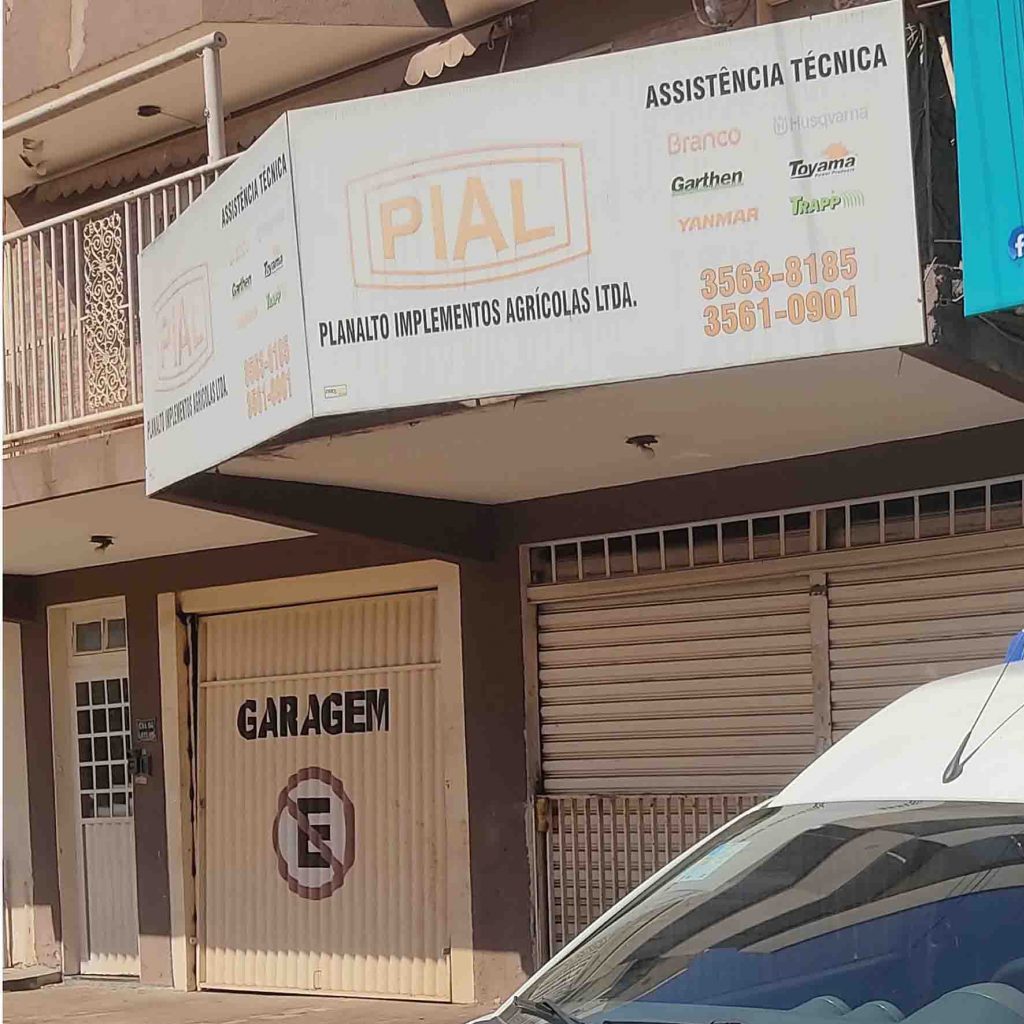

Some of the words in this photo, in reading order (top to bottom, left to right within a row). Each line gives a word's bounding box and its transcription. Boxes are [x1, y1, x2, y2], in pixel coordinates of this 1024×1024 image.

[645, 62, 784, 109] ASSISTÊNCIA
[790, 43, 888, 83] TÉCNICA
[667, 126, 742, 156] Branco
[671, 170, 744, 192] Garthen
[788, 156, 856, 179] Toyama
[380, 177, 555, 261] PIAL
[678, 207, 759, 232] YANMAR
[700, 247, 858, 300] 3563-8185
[319, 313, 390, 347] PLANALTO
[394, 299, 501, 338] IMPLEMENTOS
[506, 286, 591, 325] AGRÍCOLAS
[595, 281, 638, 313] LTDA.
[703, 285, 858, 337] 3561-0901
[237, 688, 390, 740] GARAGEM
